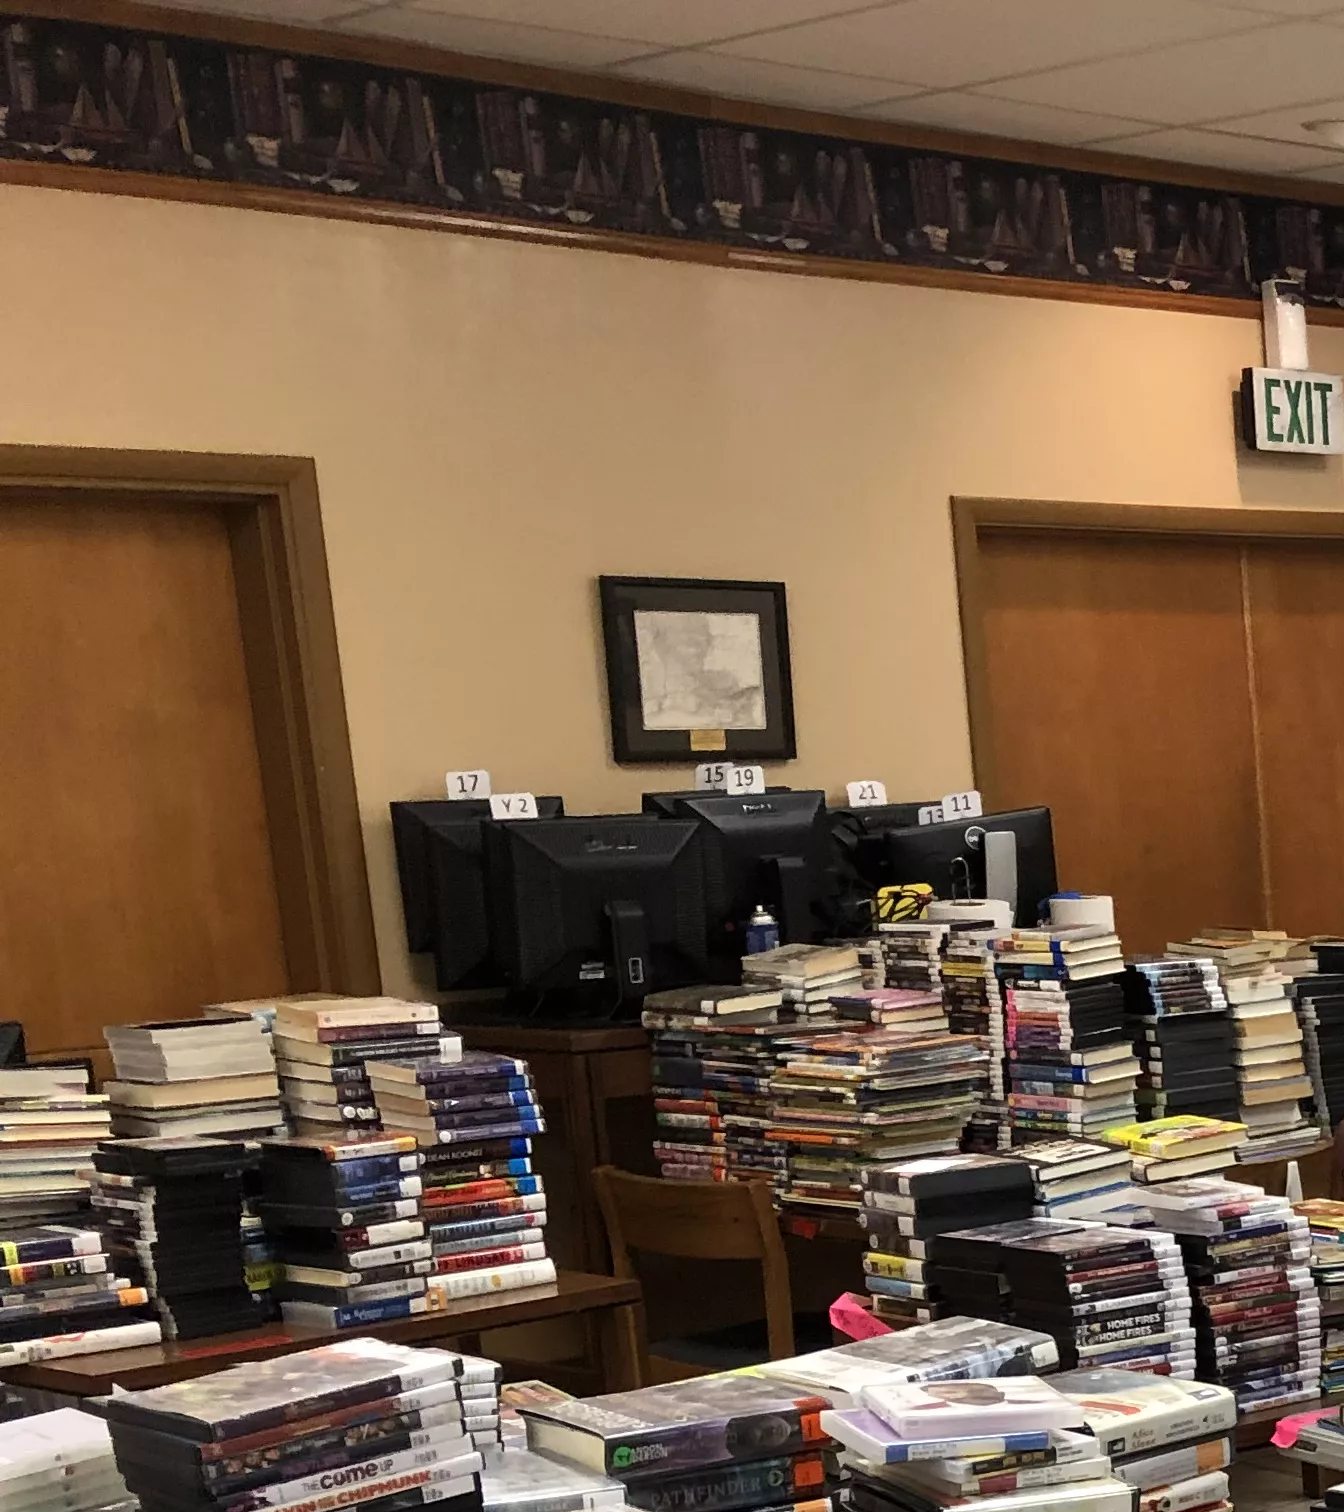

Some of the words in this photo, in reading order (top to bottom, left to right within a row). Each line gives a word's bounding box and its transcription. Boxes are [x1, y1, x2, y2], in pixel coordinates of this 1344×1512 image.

[1264, 377, 1333, 446] EXIT
[456, 774, 479, 793] 17
[704, 766, 723, 784] 15
[734, 768, 754, 787] 19
[858, 785, 878, 799] 21
[951, 795, 971, 811] 11
[1107, 1318, 1134, 1330] HOME
[1135, 1313, 1161, 1325] FIRES
[1100, 1331, 1127, 1342] HOME
[1128, 1326, 1152, 1339] FIRES
[321, 1462, 379, 1489] come
[651, 1477, 763, 1508] PATHFINDER
